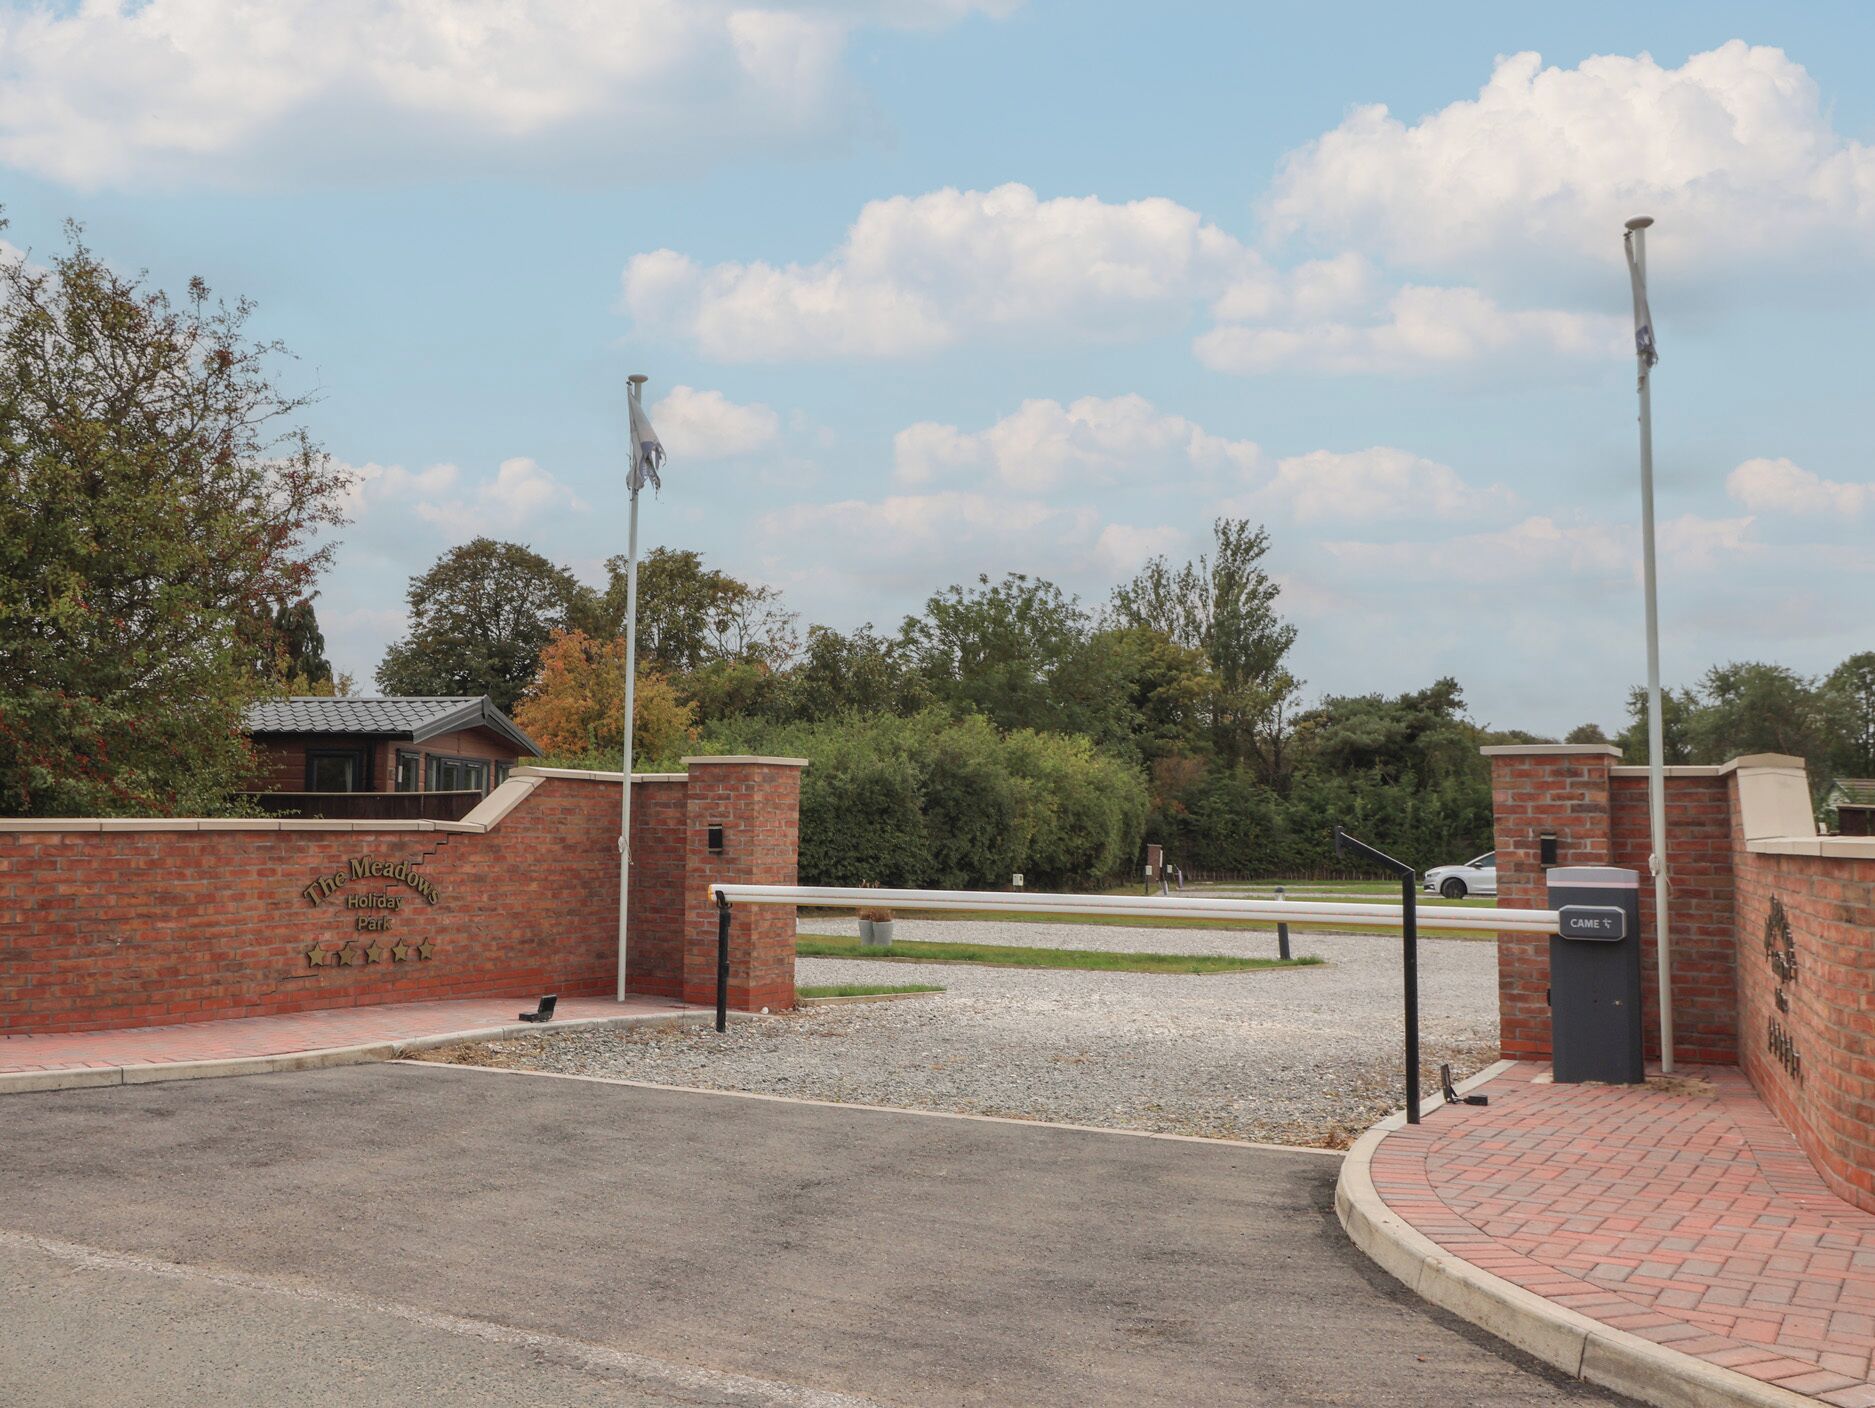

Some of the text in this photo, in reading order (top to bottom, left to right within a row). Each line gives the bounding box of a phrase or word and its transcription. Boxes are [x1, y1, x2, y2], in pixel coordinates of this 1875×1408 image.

[303, 855, 440, 908] The Meadows
[347, 893, 402, 912] Holiday
[357, 915, 393, 931] Park
[1570, 918, 1600, 929] CAME
